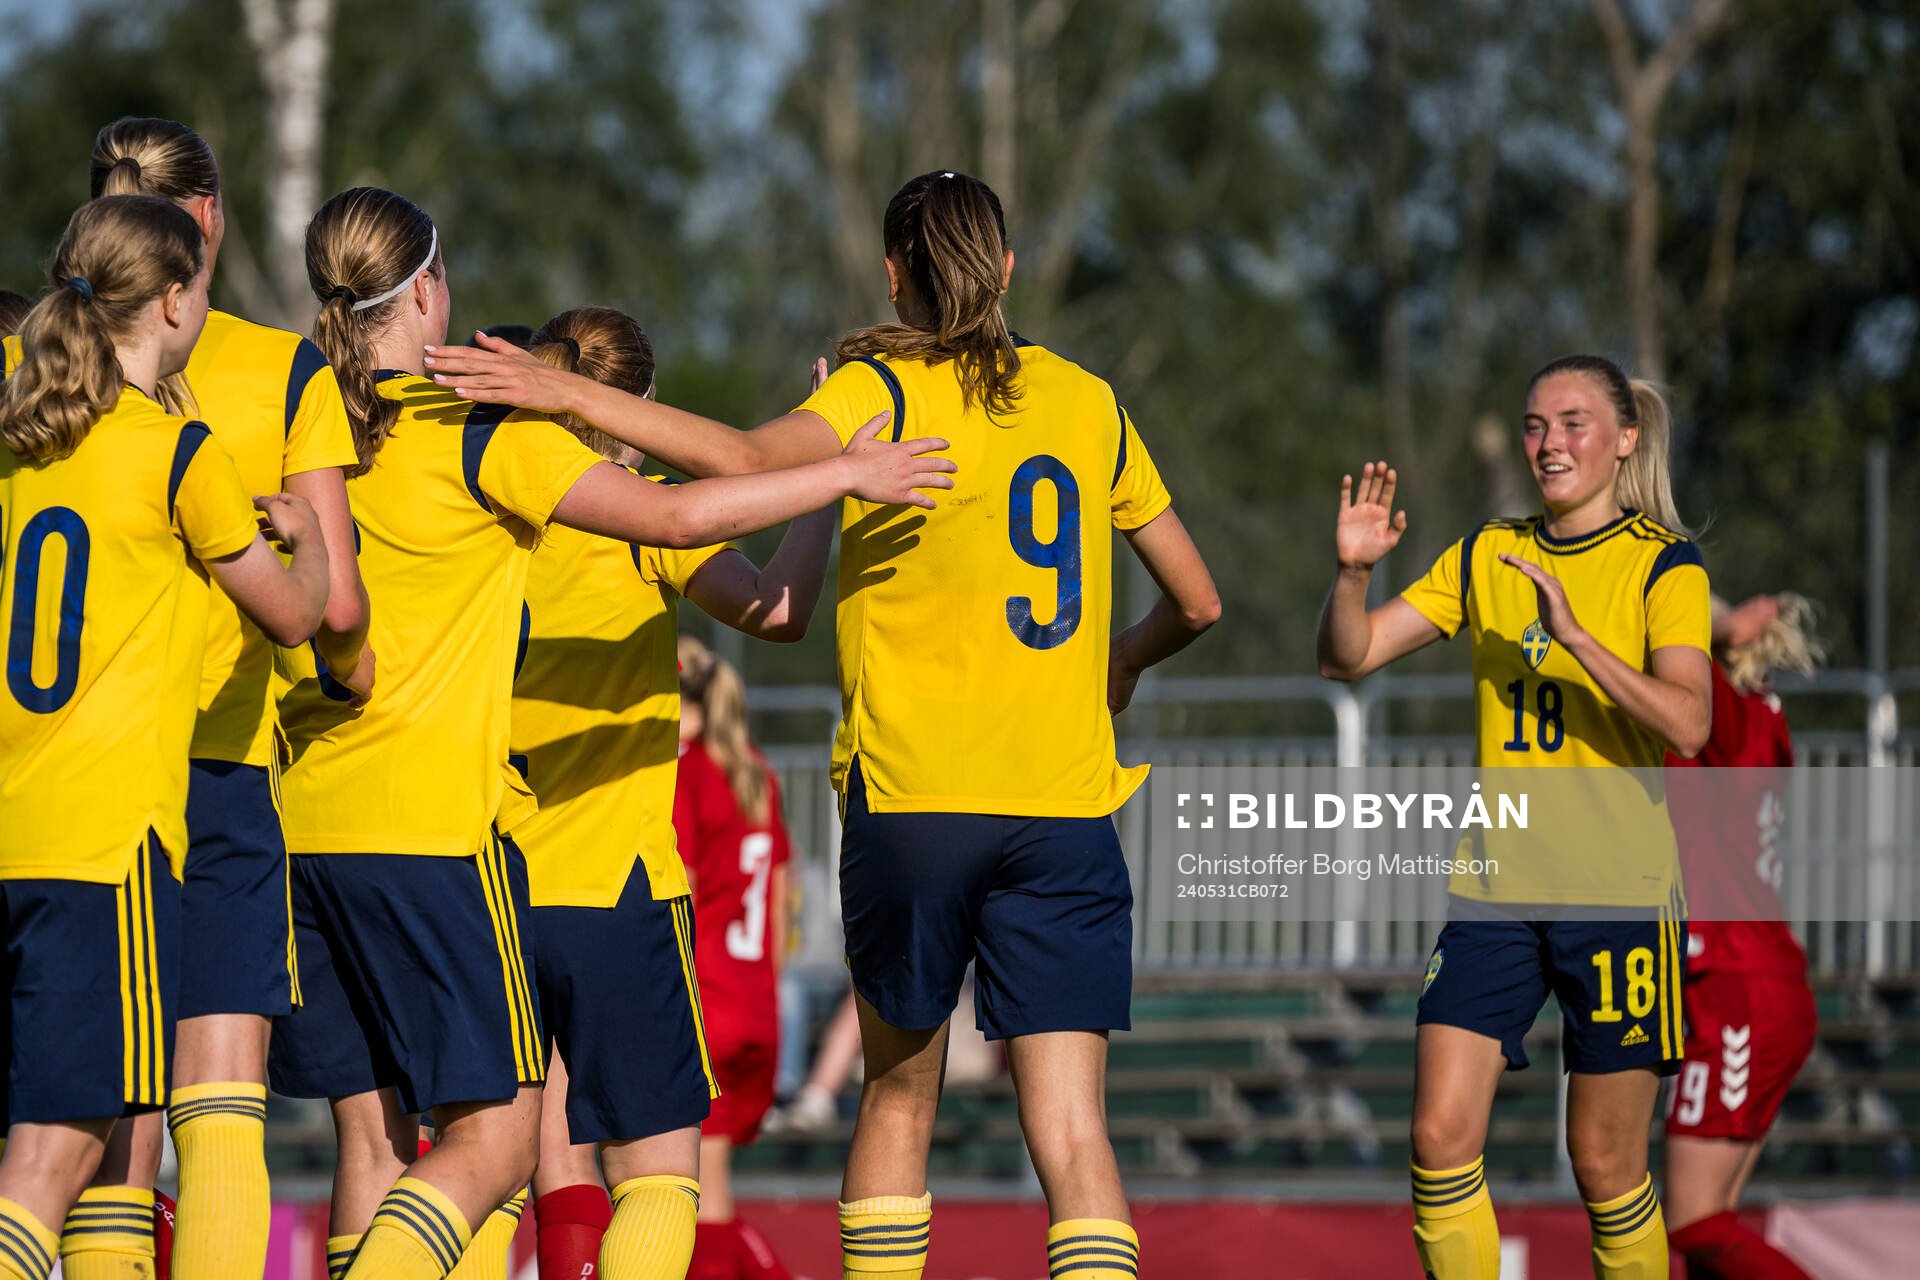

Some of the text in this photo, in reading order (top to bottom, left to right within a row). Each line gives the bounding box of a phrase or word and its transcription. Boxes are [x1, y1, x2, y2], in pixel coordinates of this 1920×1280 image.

[1006, 454, 1082, 650] 9
[1504, 679, 1564, 753] 18
[725, 832, 773, 962] 3
[1591, 946, 1656, 1022] 18
